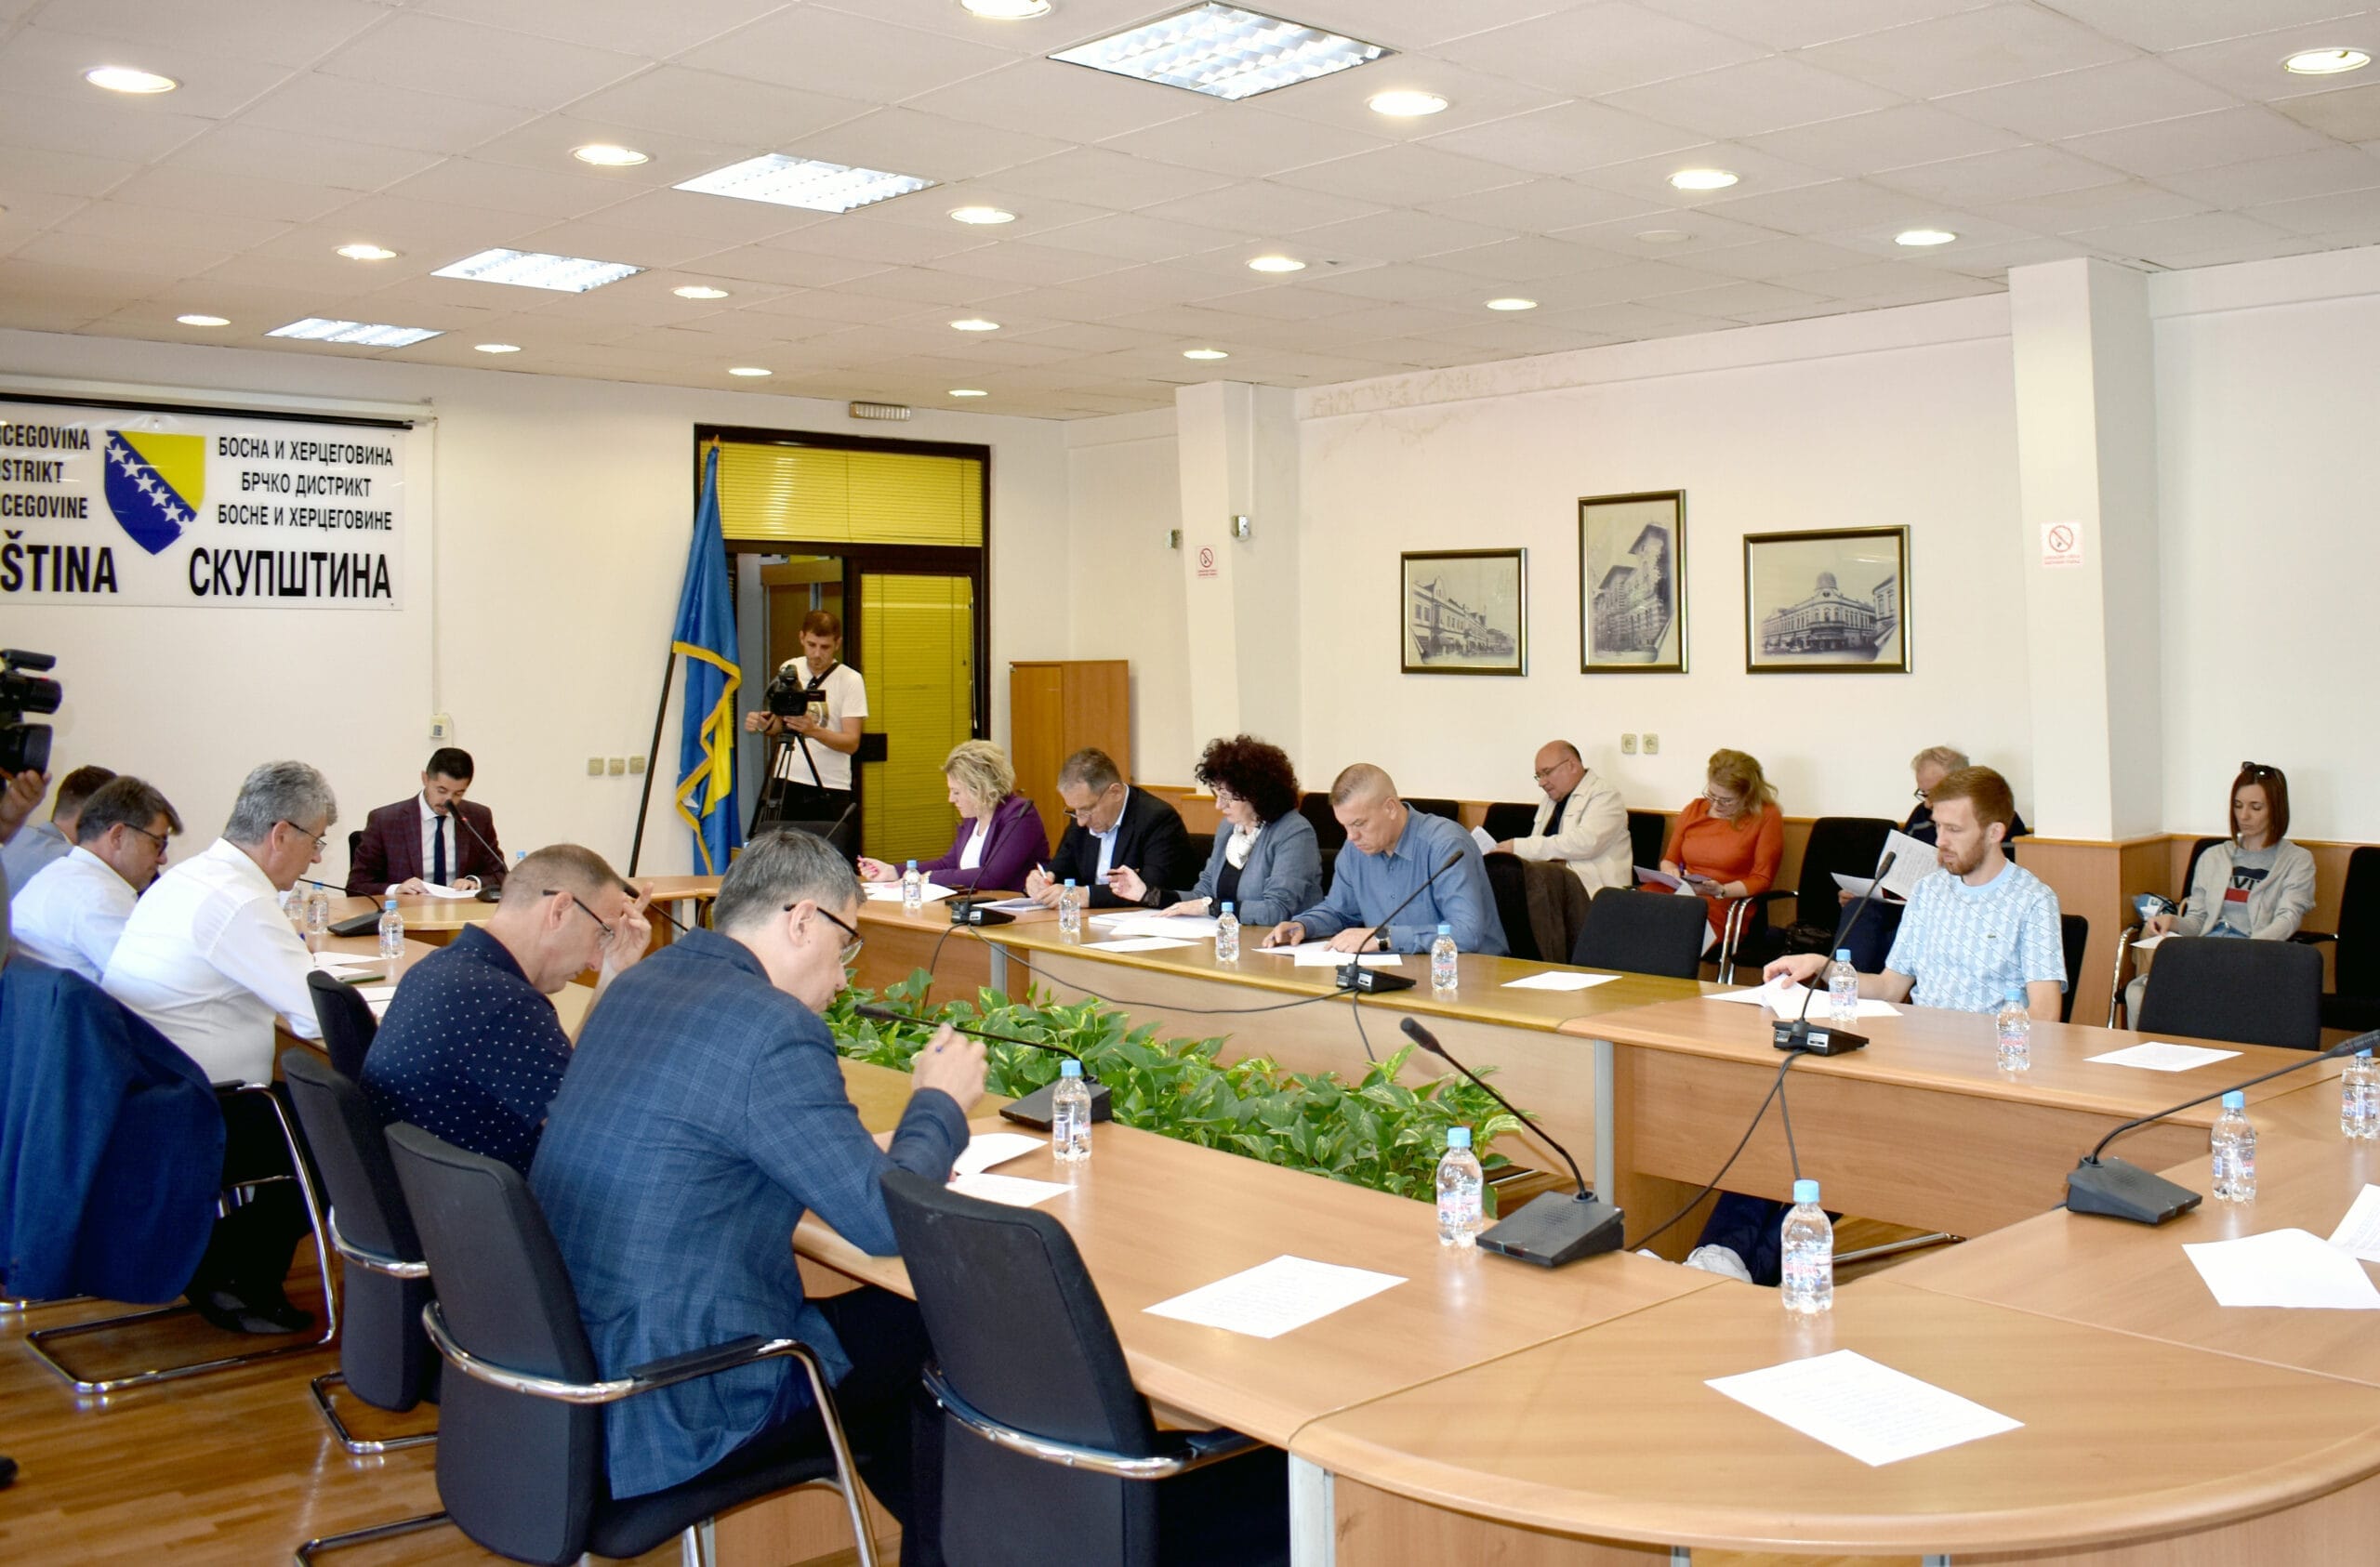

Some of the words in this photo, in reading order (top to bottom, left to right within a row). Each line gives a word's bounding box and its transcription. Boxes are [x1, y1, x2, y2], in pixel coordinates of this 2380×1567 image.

[0, 425, 90, 450] CEGOVINA
[218, 436, 270, 458] БОСНА
[275, 440, 284, 460] И
[290, 441, 393, 466] ХЕРЦЕГОВИНА
[1, 458, 63, 482] STRIKT
[242, 471, 290, 493] БРЧКО
[296, 474, 372, 498] ДИСТРИКТ
[1, 494, 88, 519] CEGOVINE
[218, 504, 269, 525] БОСНЕ
[274, 507, 284, 527] И
[289, 507, 392, 532] ХЕРЦЕГОВИНЕ
[0, 529, 118, 593] ŠTINA
[189, 546, 392, 599] СКУПШТИНА
